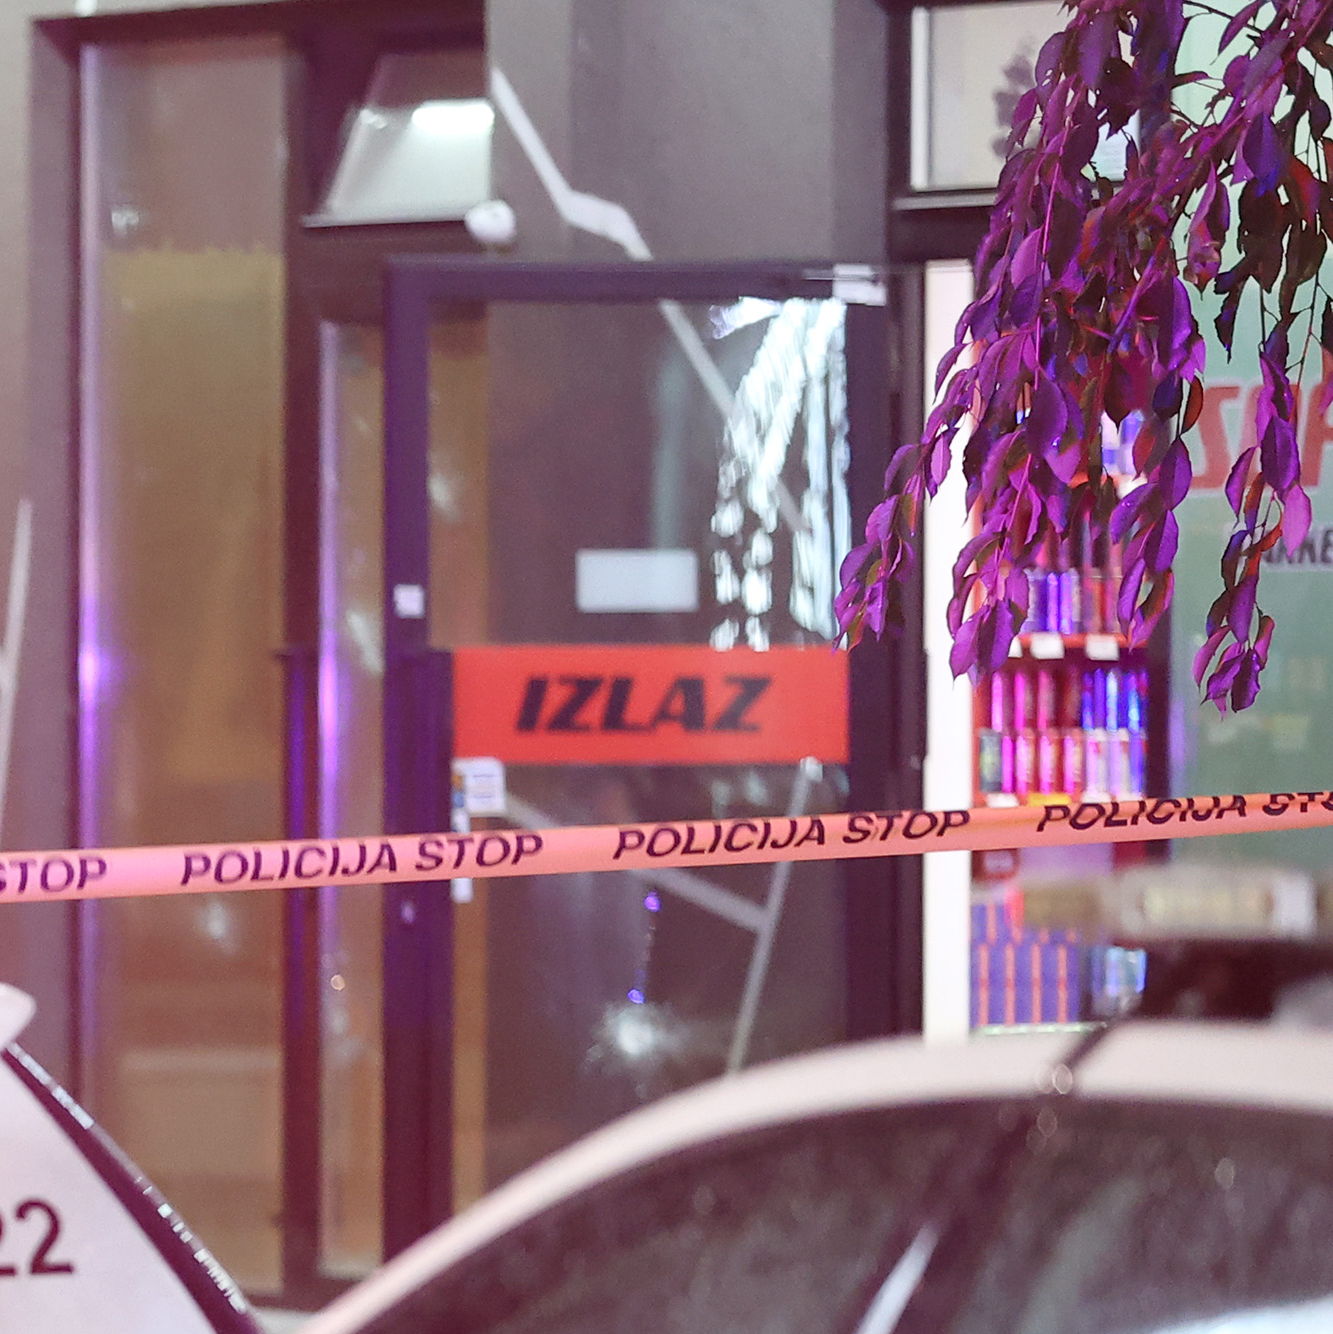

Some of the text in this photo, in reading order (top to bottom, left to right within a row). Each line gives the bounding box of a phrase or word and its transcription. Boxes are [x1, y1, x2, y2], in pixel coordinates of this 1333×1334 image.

[515, 674, 774, 734] IZLAZ
[181, 832, 544, 888] POLICIJA STOP
[613, 810, 970, 860] POLICIJA STOP
